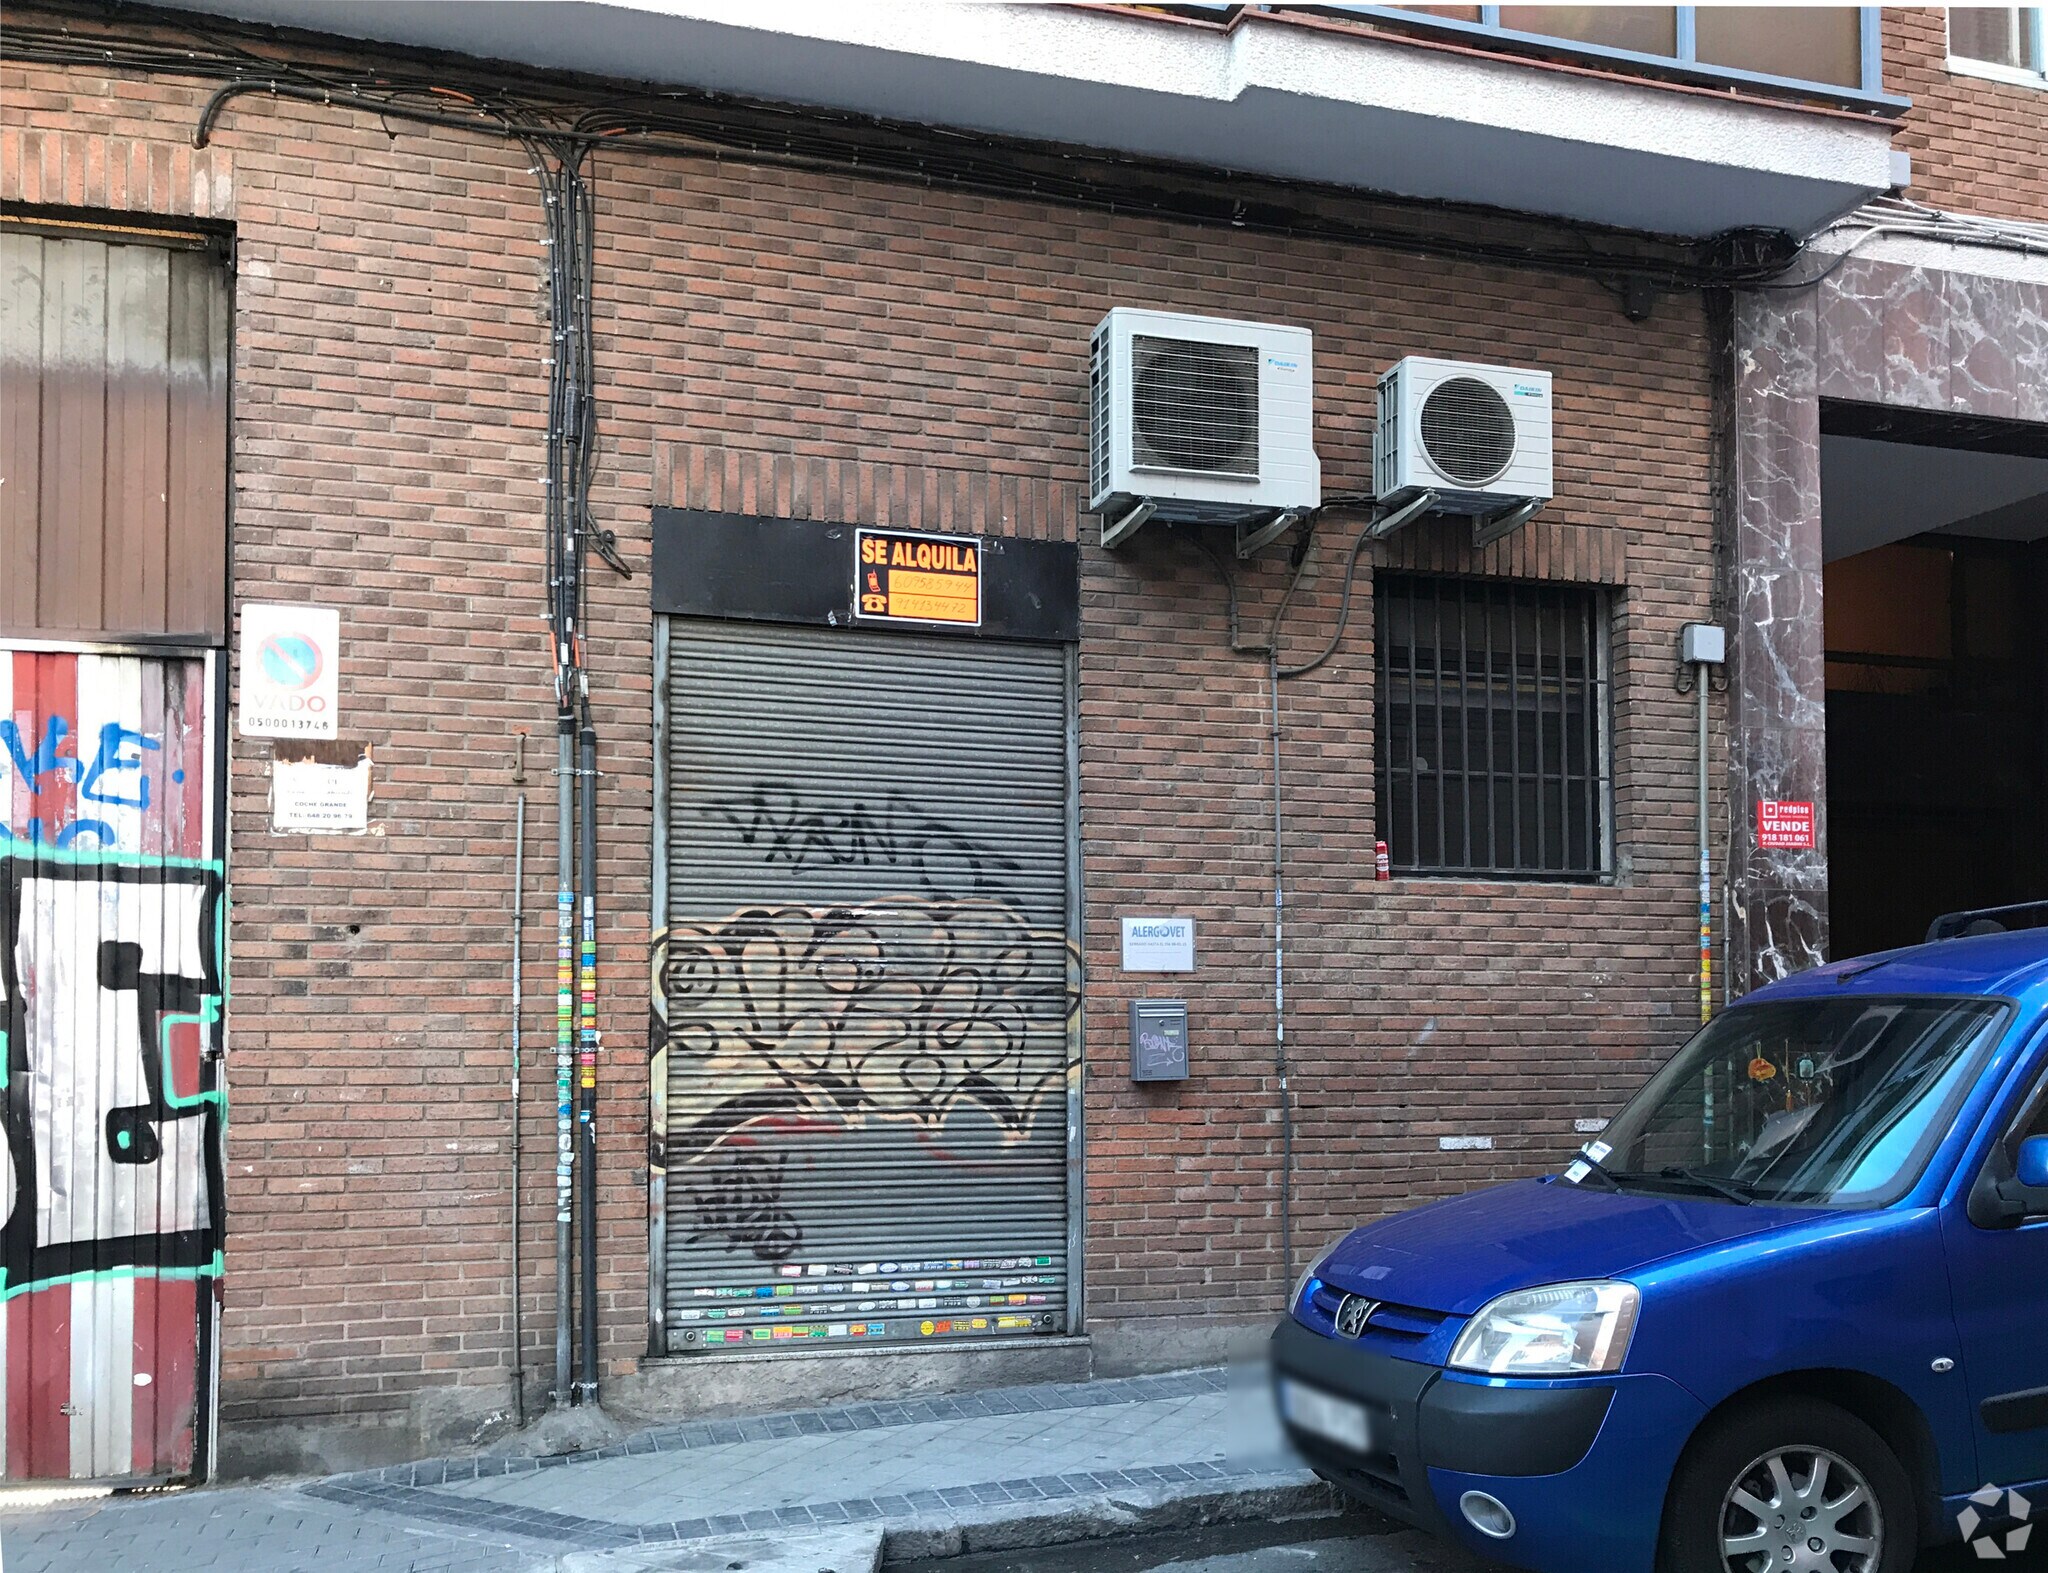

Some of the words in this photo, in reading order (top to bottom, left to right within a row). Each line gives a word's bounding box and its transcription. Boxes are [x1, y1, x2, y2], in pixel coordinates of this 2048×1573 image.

[861, 539, 888, 565] SE
[891, 542, 977, 572] ALQUILA
[253, 694, 327, 713] VADO
[1762, 821, 1810, 832] VENDE
[1762, 834, 1777, 842] 918
[1794, 834, 1809, 842] 061
[1131, 925, 1186, 938] ALERGOVET
